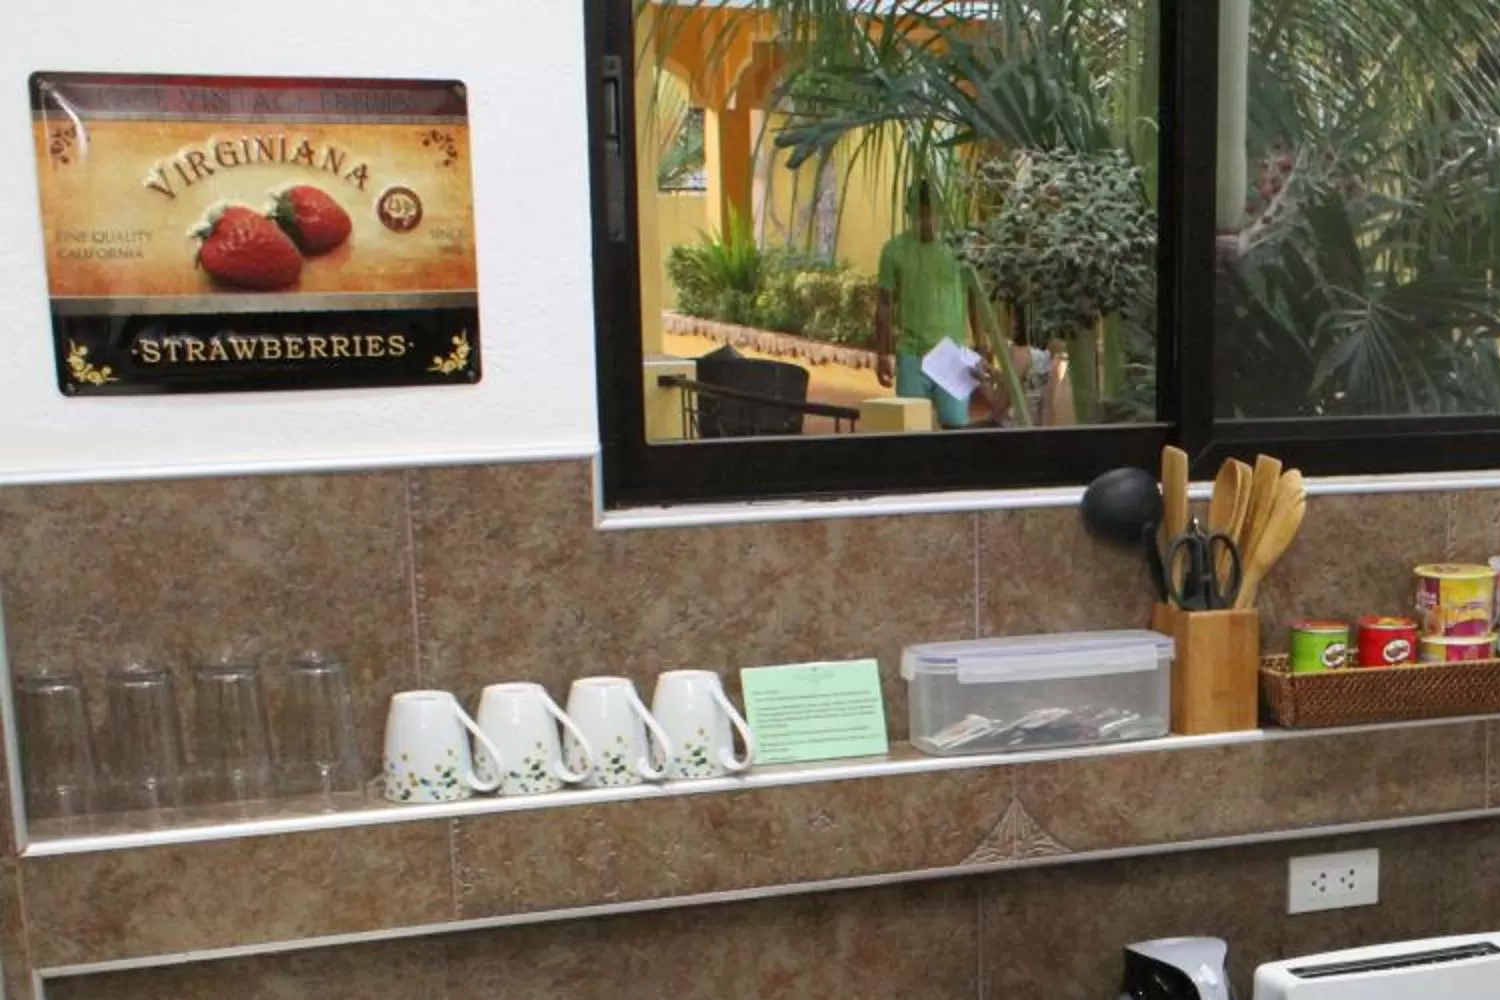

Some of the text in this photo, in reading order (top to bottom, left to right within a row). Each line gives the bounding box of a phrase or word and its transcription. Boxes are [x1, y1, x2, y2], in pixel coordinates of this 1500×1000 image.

[145, 134, 369, 201] VIRGINIANA
[91, 229, 153, 244] QUALITY
[138, 334, 406, 364] STRAWBERRIES
